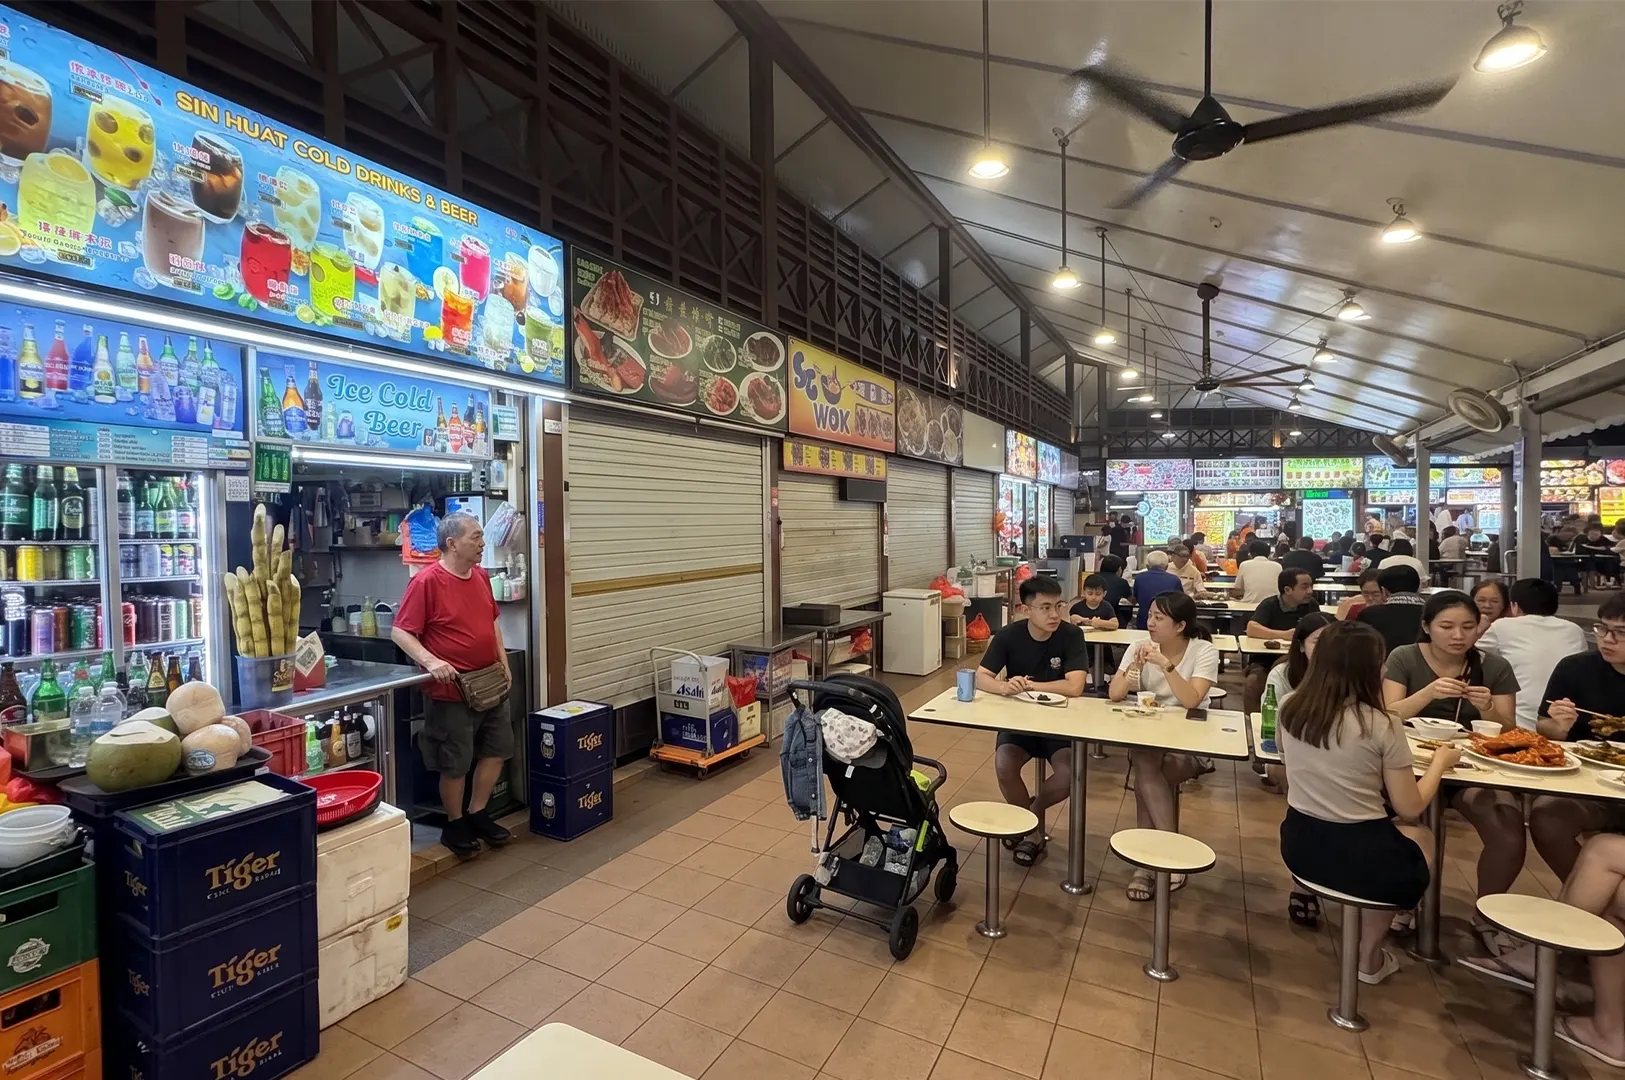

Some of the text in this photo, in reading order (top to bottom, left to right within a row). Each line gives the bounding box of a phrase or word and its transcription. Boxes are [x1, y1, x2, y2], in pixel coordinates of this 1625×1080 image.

[176, 91, 479, 227] SIN HUAT COLD DRINKS & BEER
[327, 374, 433, 412] Ice Cold
[364, 410, 423, 438] Beer
[676, 683, 705, 699] Asahi
[576, 732, 603, 752] Tiger
[577, 791, 603, 810] Tiger
[124, 869, 148, 897] Tiger
[204, 850, 281, 891] Tiger
[207, 943, 282, 987] Tiger
[210, 1030, 283, 1078] Tiger
